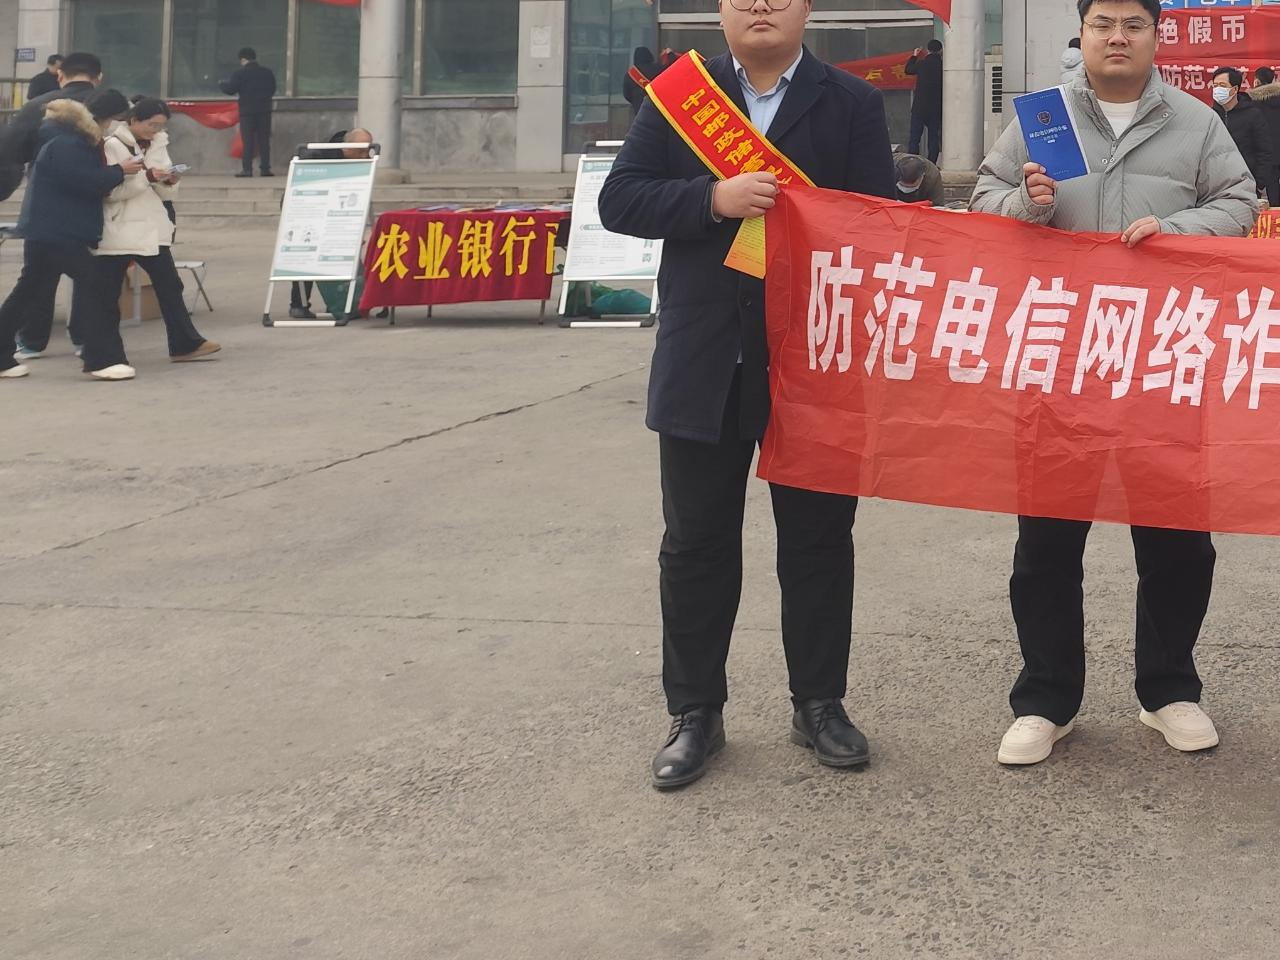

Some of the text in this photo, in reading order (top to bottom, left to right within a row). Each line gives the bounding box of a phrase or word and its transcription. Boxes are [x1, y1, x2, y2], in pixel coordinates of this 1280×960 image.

[681, 88, 793, 185] 中国邮政储蓄
